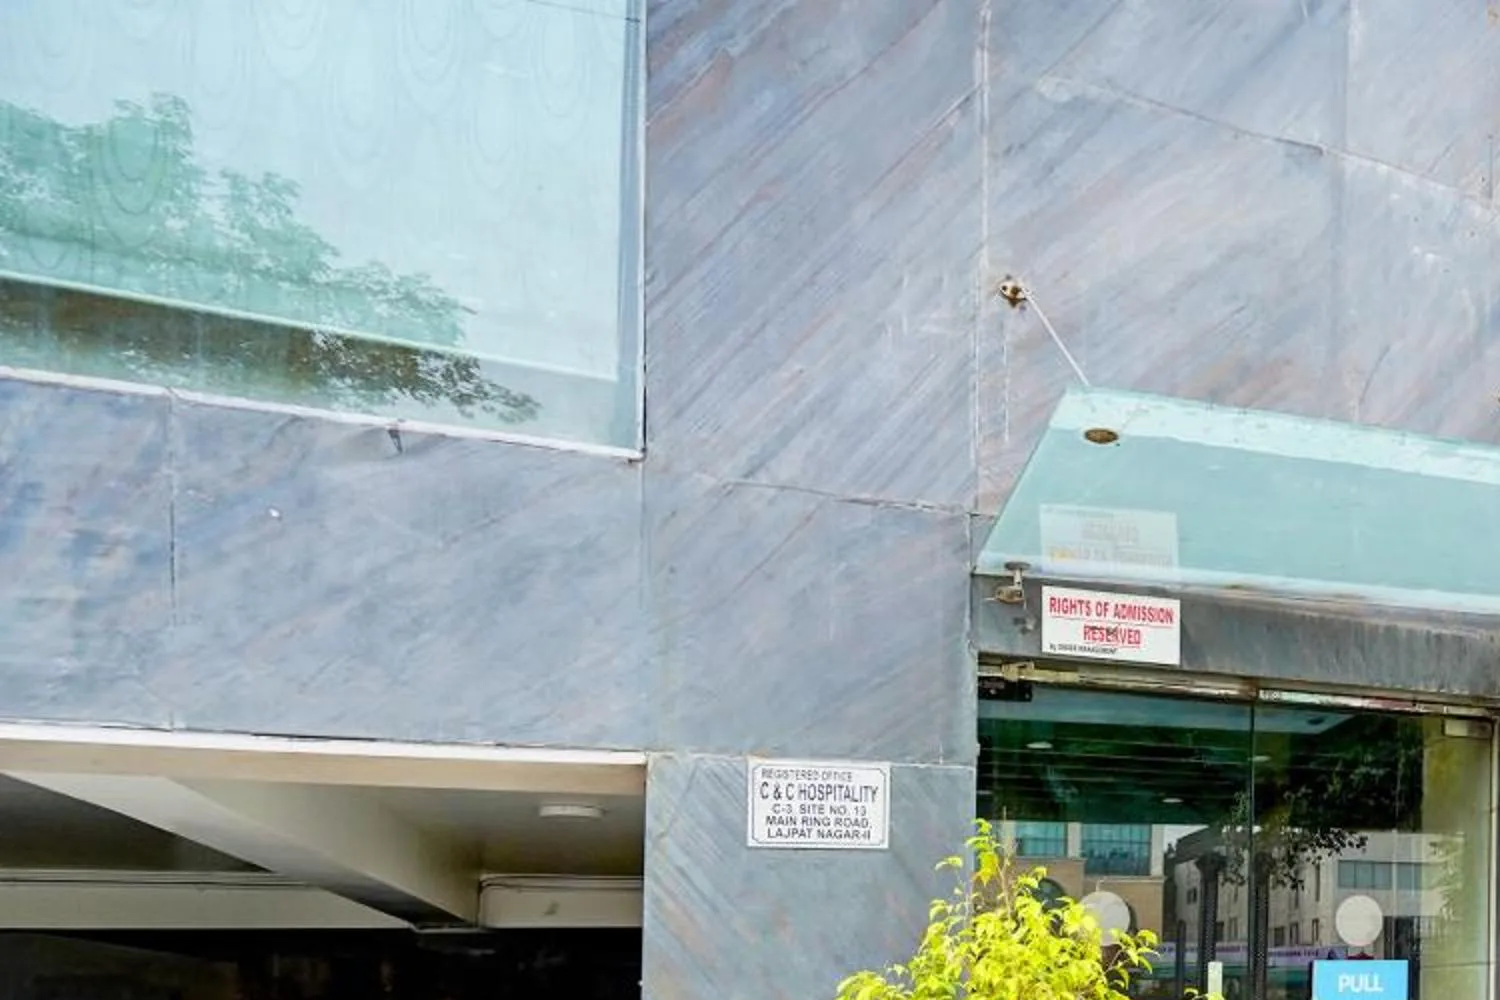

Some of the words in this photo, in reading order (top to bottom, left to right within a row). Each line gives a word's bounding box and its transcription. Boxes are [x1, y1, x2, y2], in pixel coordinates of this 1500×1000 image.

[1049, 597, 1091, 616] RIGHTS
[1095, 601, 1109, 618] OF
[1113, 603, 1174, 624] ADMISSION
[1083, 625, 1141, 646] RESERVED
[761, 768, 819, 781] REGISTERED
[821, 771, 853, 782] OFFICE
[760, 781, 769, 800] C
[773, 782, 782, 801] &
[785, 783, 795, 801] C
[798, 783, 879, 803] HOSPITALITY
[799, 804, 825, 815] SITE
[854, 805, 867, 817] 13
[765, 816, 797, 827] MAIN
[801, 816, 831, 828] RING
[767, 828, 813, 839] LAJPAT
[1337, 972, 1385, 993] PULL
